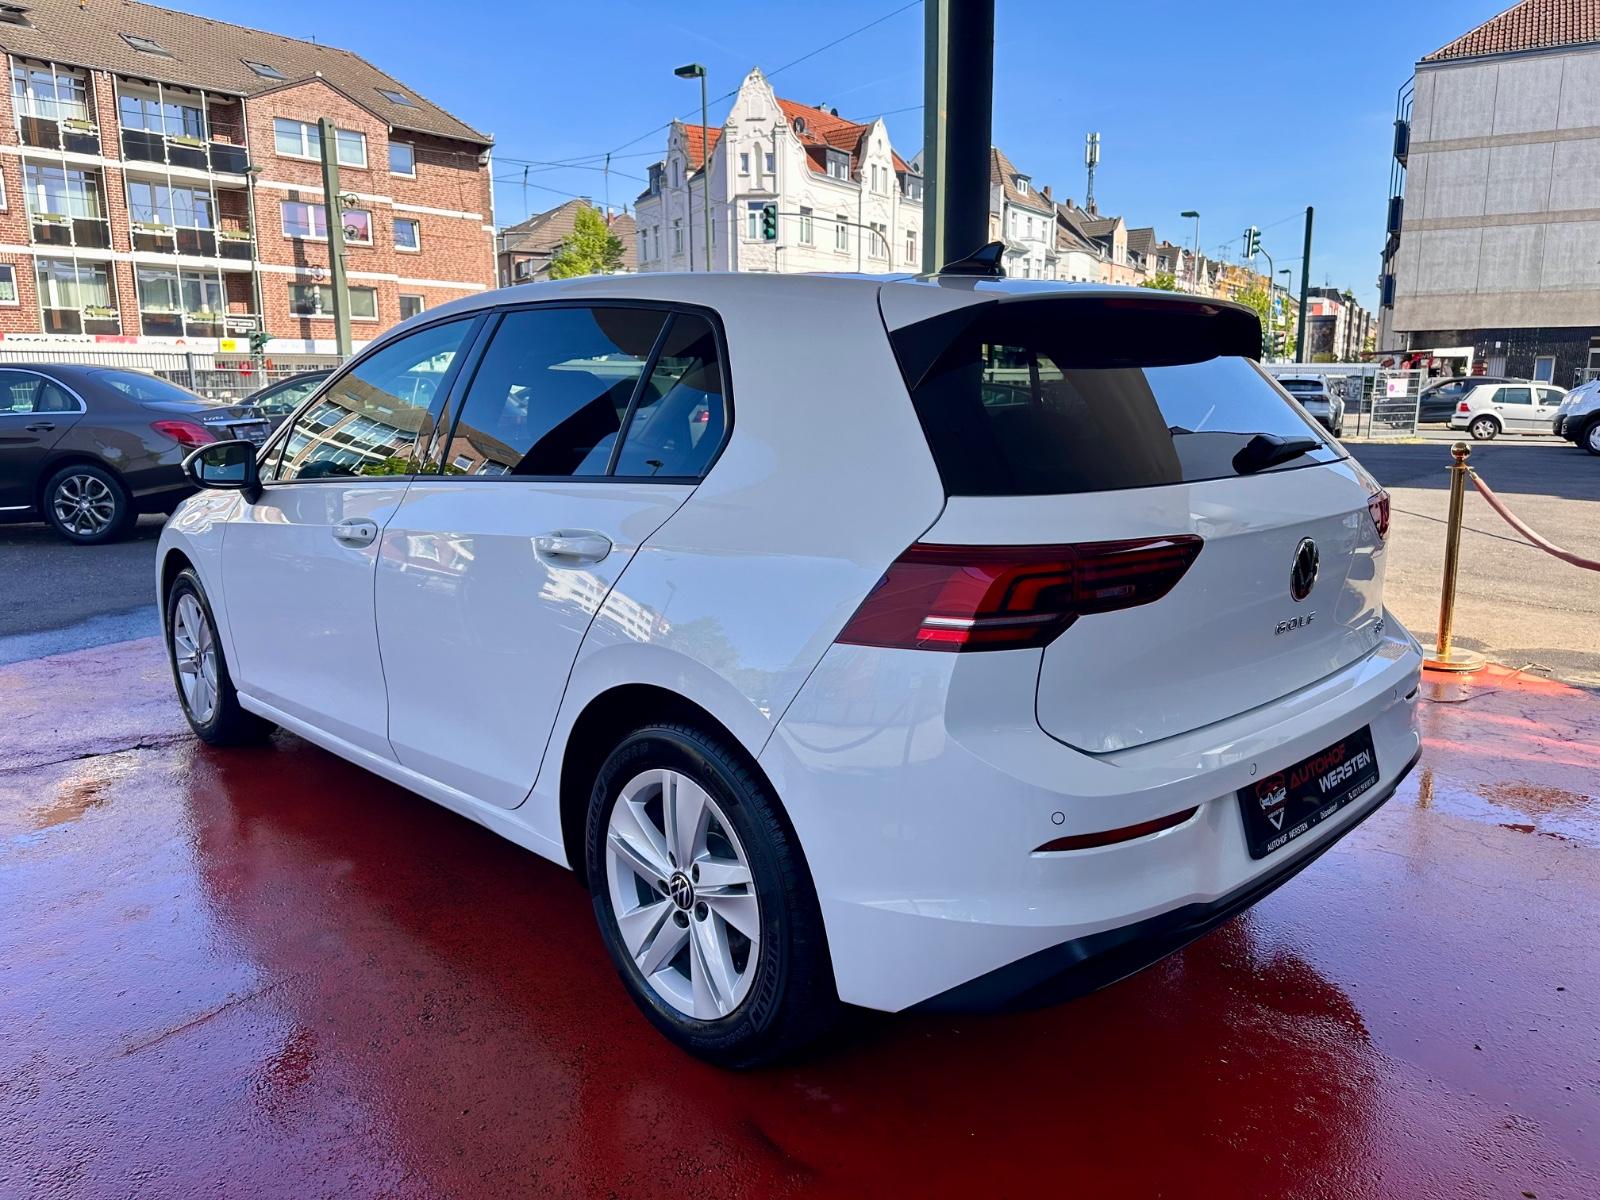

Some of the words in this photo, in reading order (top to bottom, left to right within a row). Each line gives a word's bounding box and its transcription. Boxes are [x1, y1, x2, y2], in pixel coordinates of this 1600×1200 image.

[1275, 611, 1316, 635] GOLF
[1289, 743, 1345, 789] AUTOHOF
[1319, 748, 1370, 793] WERSTEN
